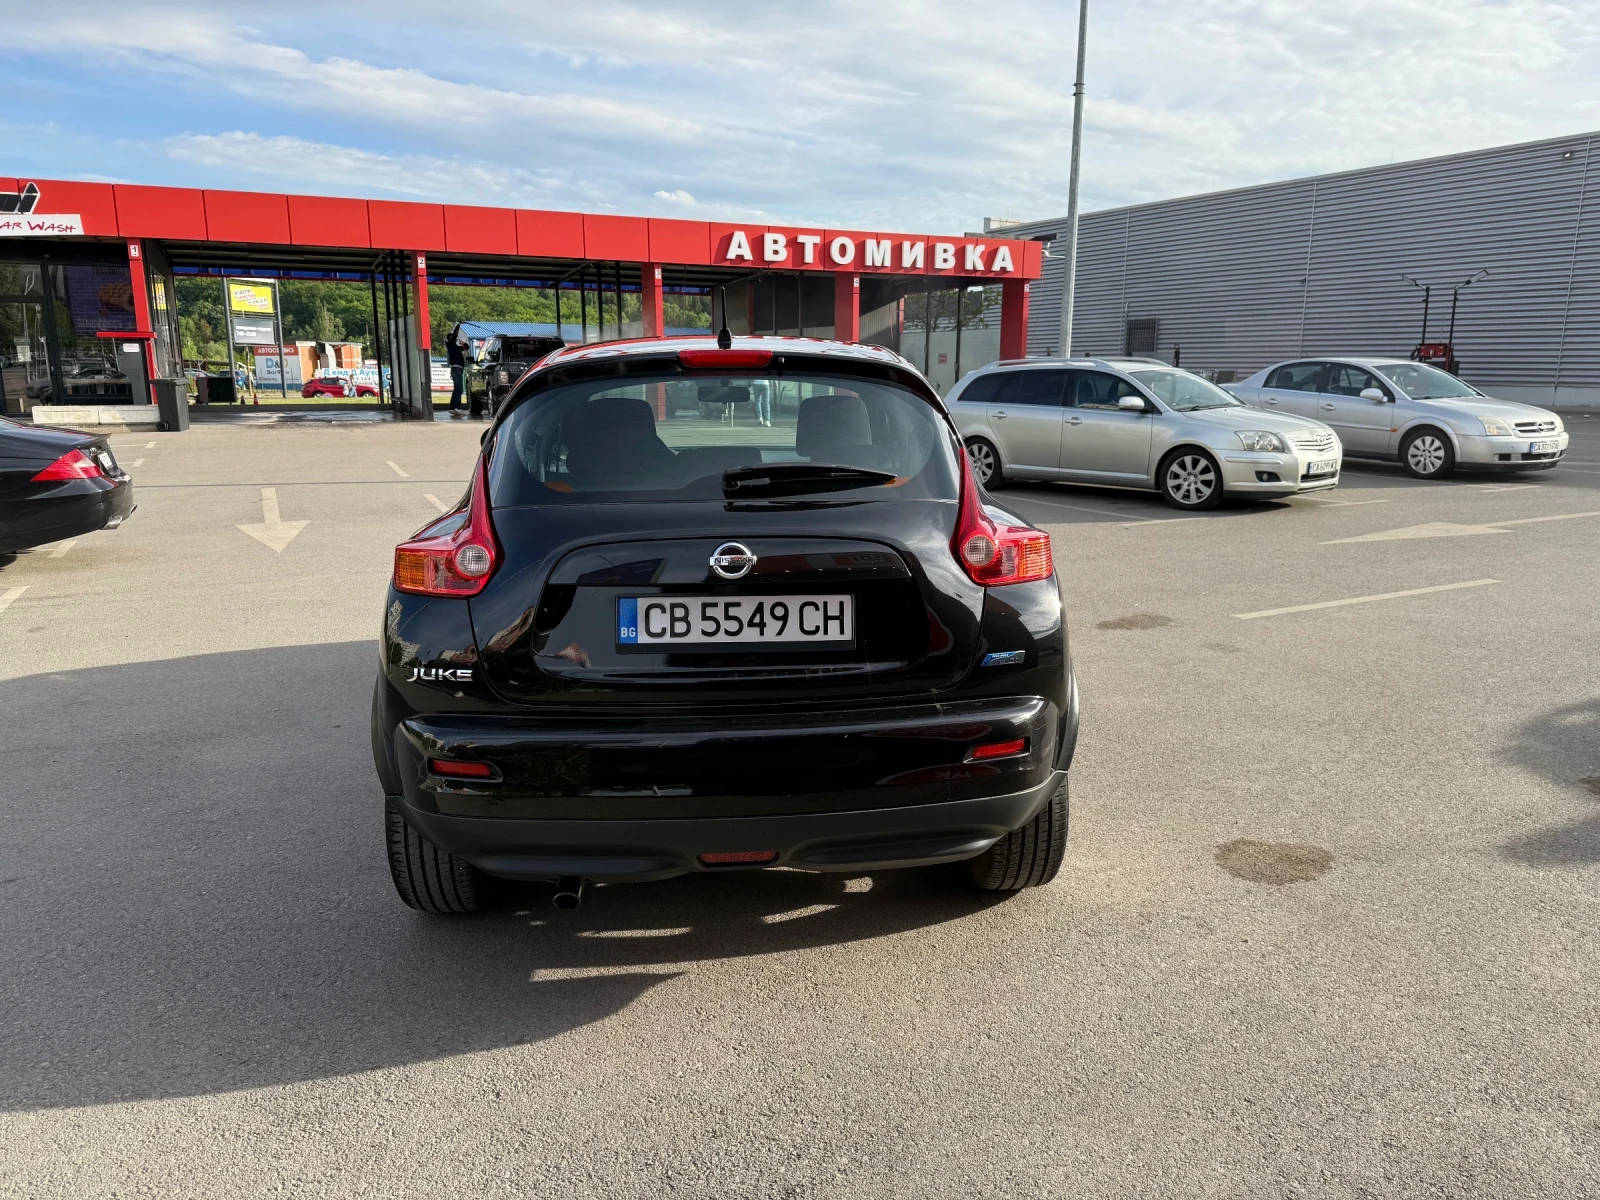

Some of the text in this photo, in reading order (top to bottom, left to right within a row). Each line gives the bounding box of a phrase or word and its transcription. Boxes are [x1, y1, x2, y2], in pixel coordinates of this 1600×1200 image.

[0, 220, 77, 233] AR WASH
[726, 230, 1014, 272] АВТОМИВКА
[714, 556, 749, 565] NISSAN
[644, 600, 845, 639] CB 5549 CH
[620, 627, 636, 638] BG
[406, 667, 473, 682] JUKE
